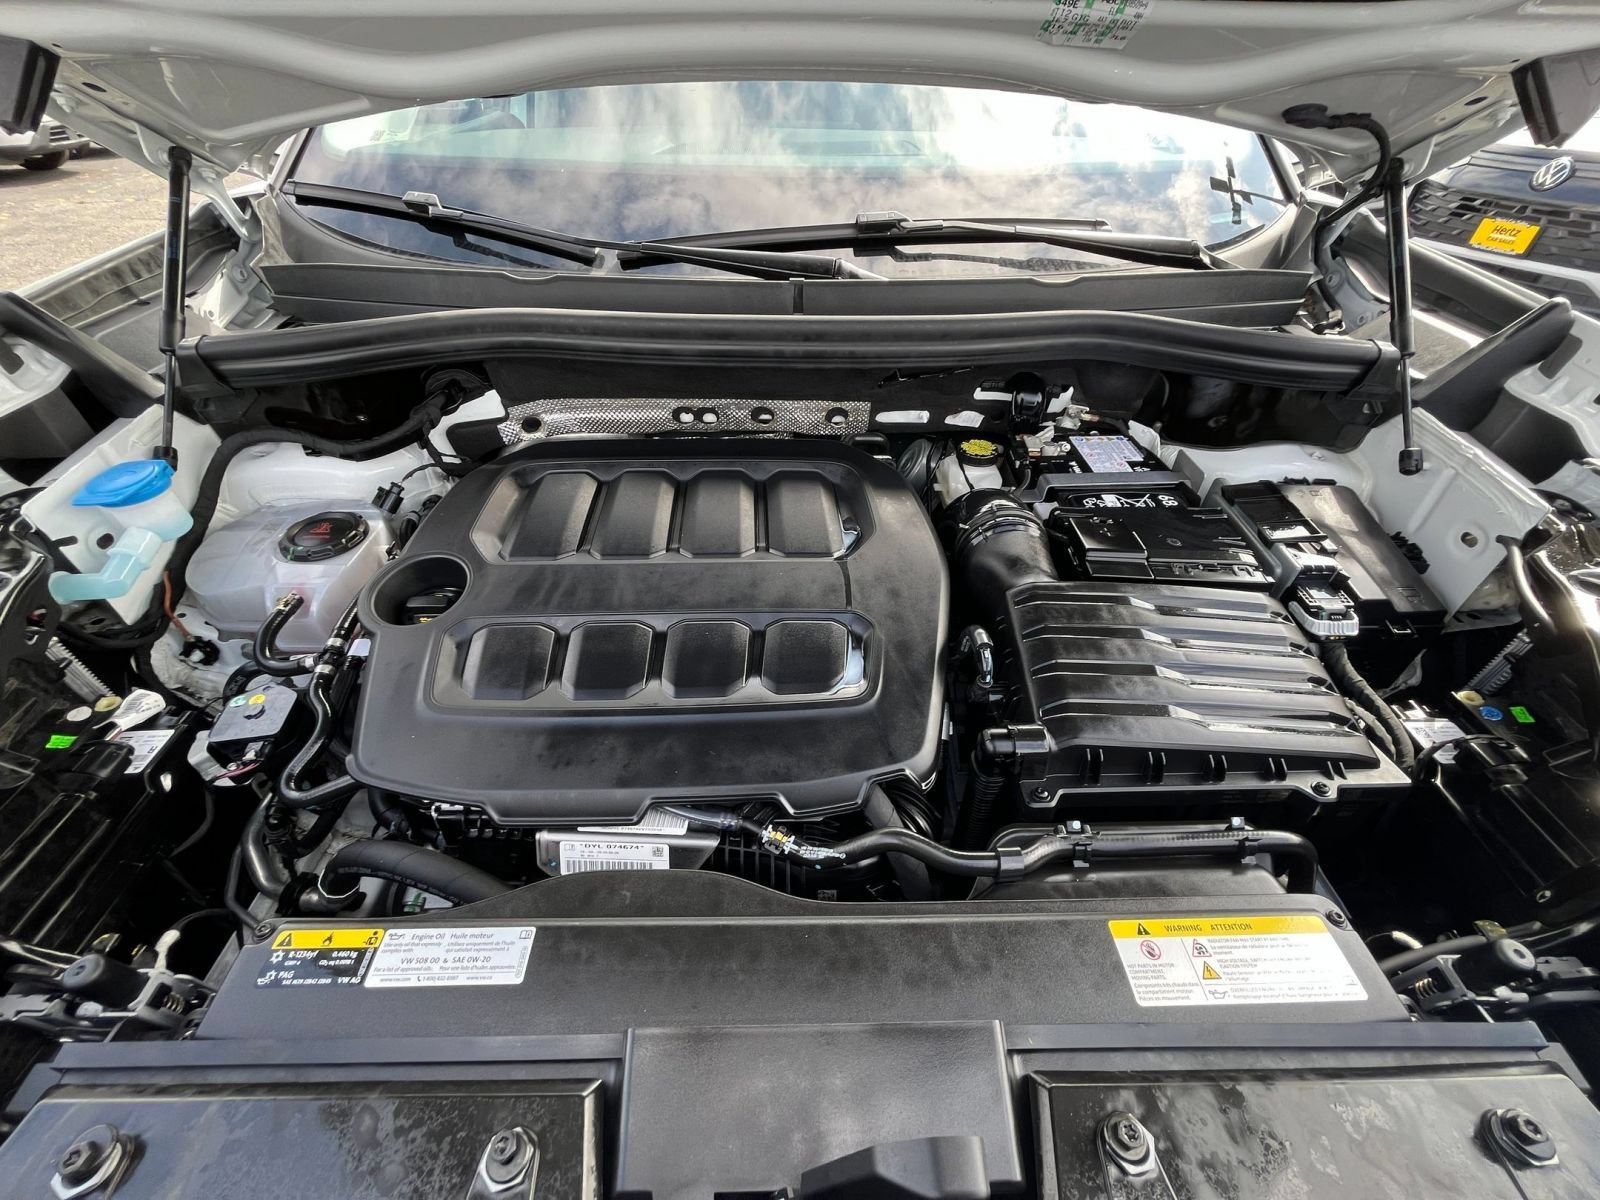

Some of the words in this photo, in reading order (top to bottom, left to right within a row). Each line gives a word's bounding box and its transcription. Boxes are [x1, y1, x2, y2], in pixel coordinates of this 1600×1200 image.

[1491, 225, 1521, 237] Hertz
[1164, 924, 1203, 933] WARNING
[1210, 923, 1253, 931] ATTENTION
[411, 933, 435, 942] Engine
[288, 950, 320, 960] R-1234yf
[350, 950, 358, 958] kg
[278, 970, 295, 978] PAG
